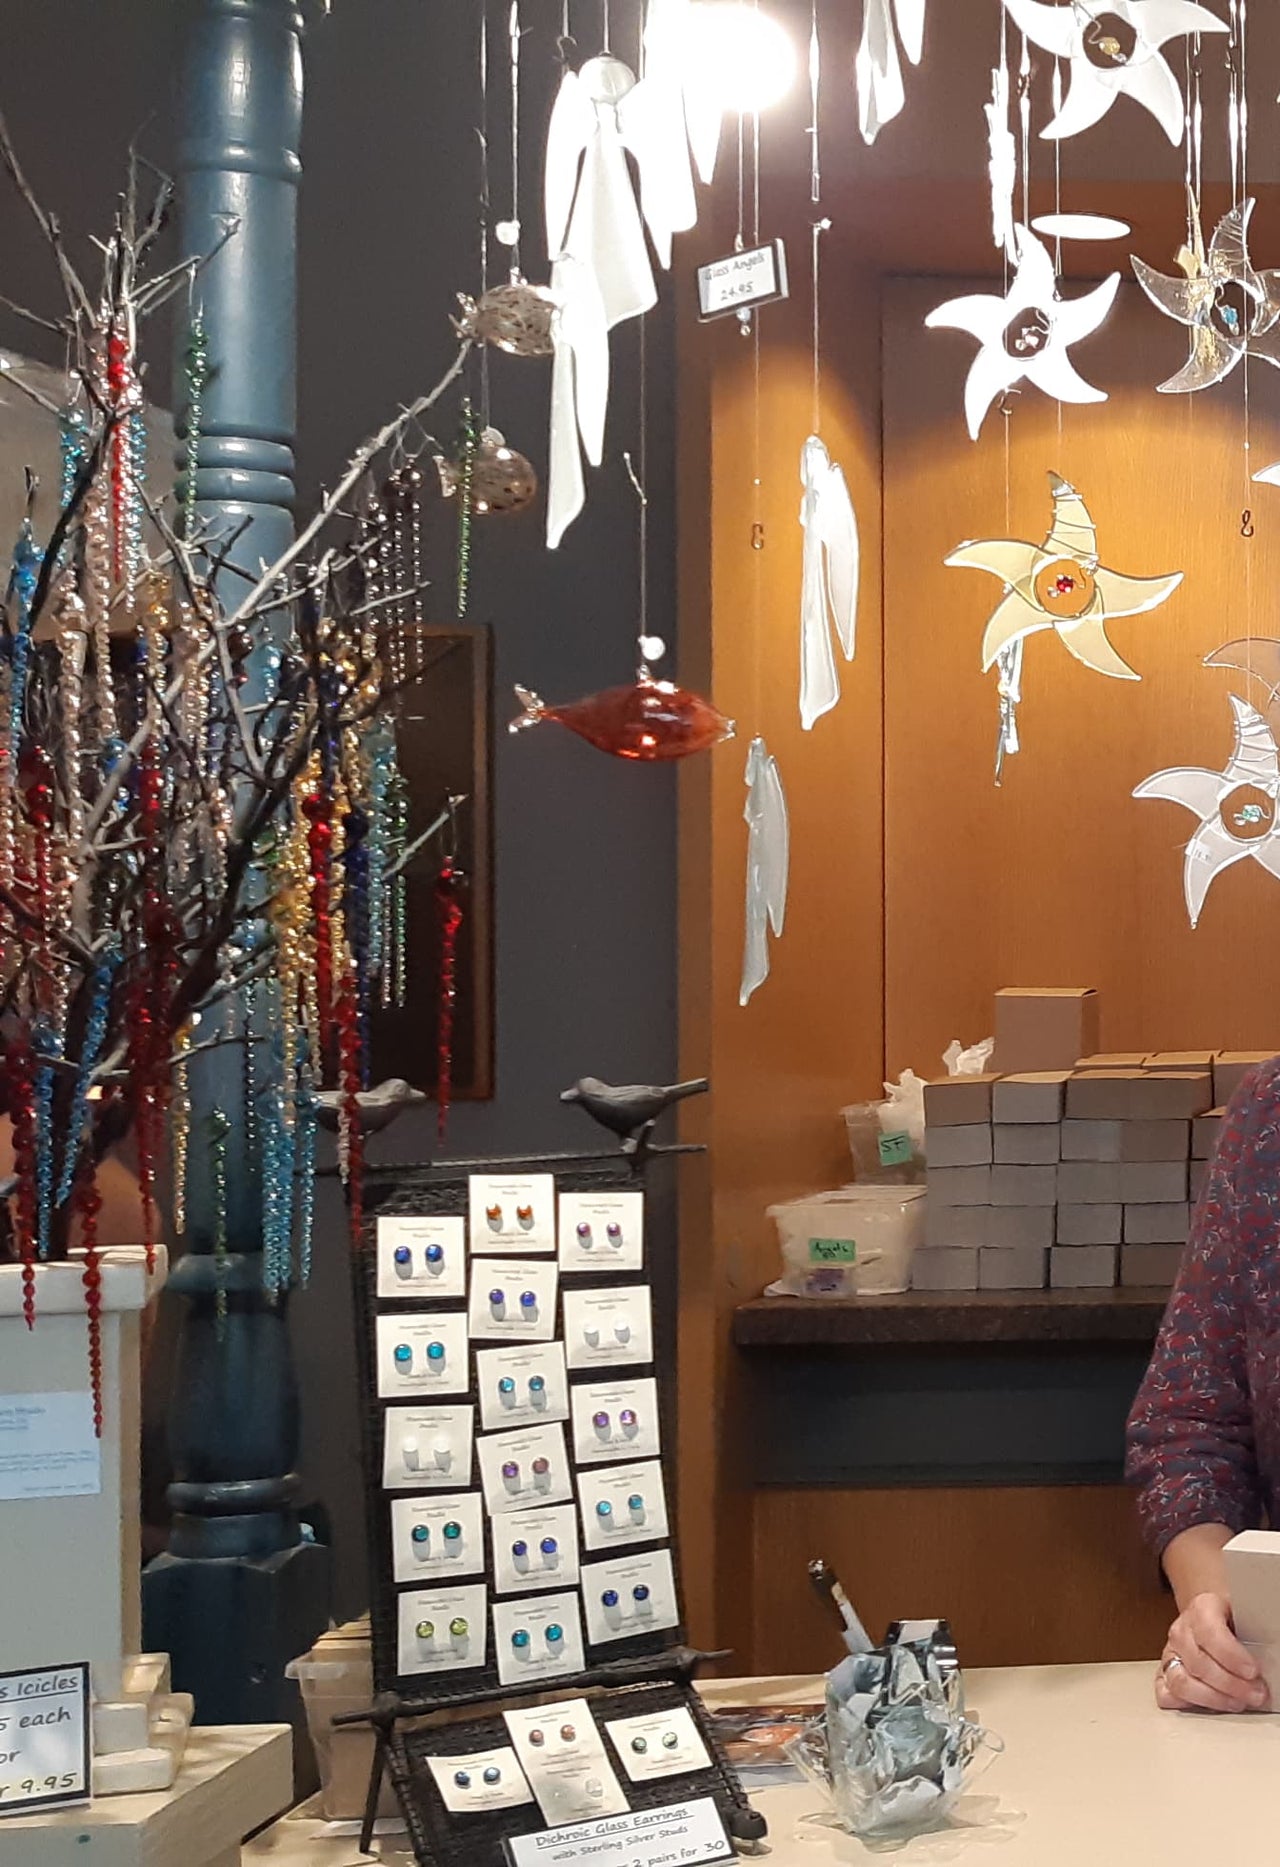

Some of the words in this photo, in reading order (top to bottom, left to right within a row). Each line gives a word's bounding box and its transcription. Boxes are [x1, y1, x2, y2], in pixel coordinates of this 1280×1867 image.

[17, 1675, 78, 1697] Icicles
[19, 1706, 71, 1729] each
[21, 1772, 78, 1794] 9.95
[536, 1827, 590, 1846] Dichroic
[595, 1820, 628, 1834] Glass
[633, 1808, 689, 1826] Earrings
[580, 1841, 623, 1855] Sterling
[626, 1834, 655, 1846] Silver
[659, 1826, 688, 1838] Studs
[648, 1853, 678, 1866] pairs
[680, 1847, 698, 1858] for
[704, 1840, 725, 1852] 30
